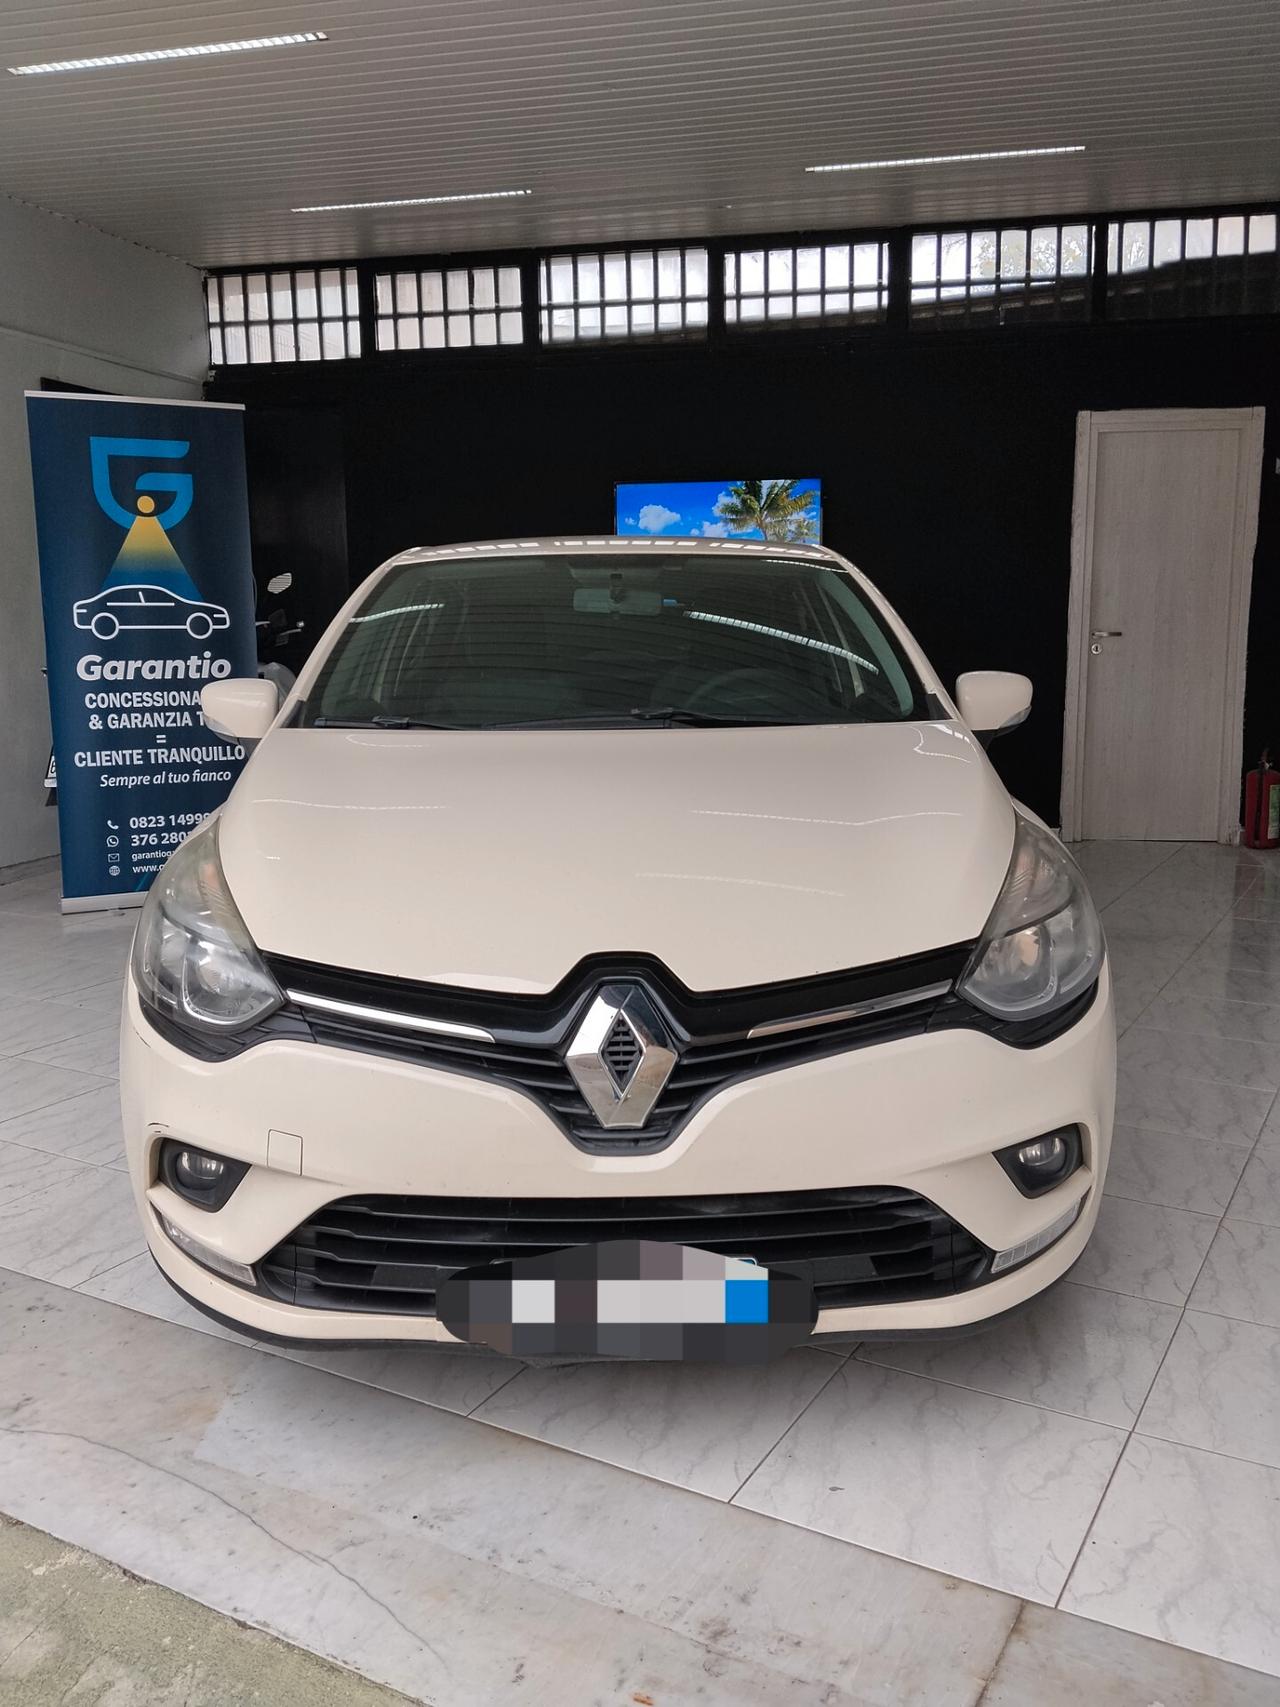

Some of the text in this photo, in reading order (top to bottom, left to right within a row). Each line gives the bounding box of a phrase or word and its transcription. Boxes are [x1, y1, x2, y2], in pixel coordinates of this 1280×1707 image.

[76, 651, 232, 681] Garantio
[84, 690, 202, 709] CONCESSIONA
[88, 715, 103, 729] &
[107, 711, 193, 728] GARANZIA
[74, 750, 143, 767] CLIENTE
[147, 745, 245, 764] TRANQUILLO
[100, 769, 231, 789] Sempre al tuo fianco
[129, 815, 166, 829] 0823
[131, 830, 193, 847] 376 280
[131, 850, 176, 861] garantiog
